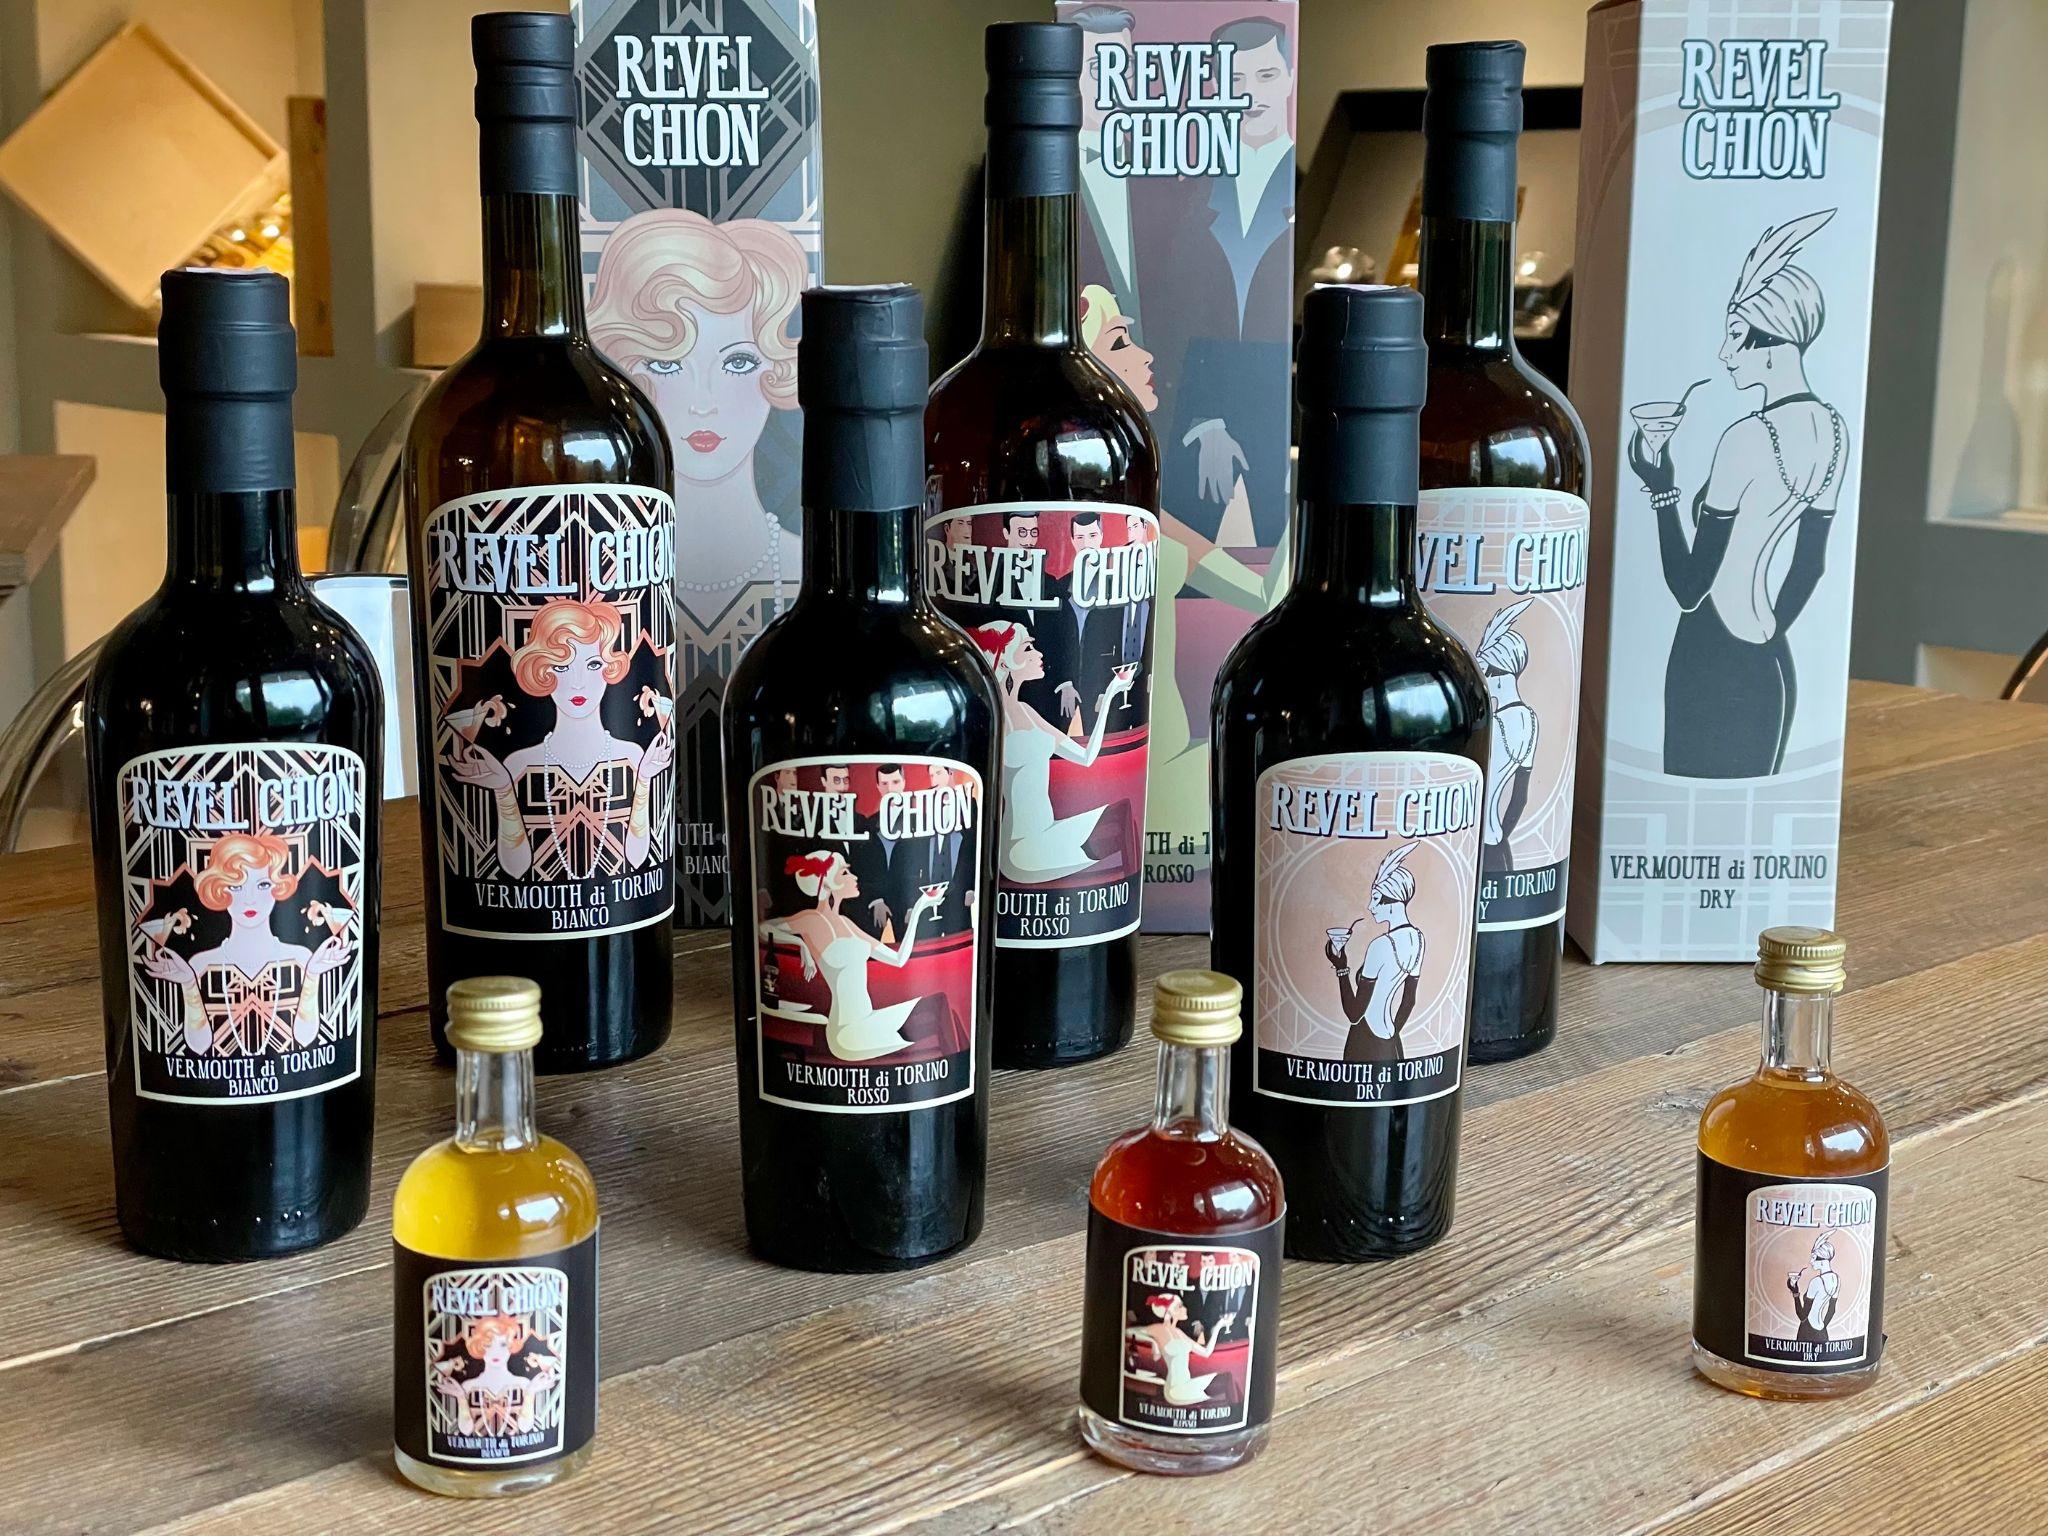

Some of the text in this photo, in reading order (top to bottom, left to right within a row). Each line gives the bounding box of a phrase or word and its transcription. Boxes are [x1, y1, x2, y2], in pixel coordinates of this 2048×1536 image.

[613, 35, 770, 99] REVEL
[1096, 43, 1252, 108] REVEL
[1680, 40, 1840, 109] REVEL
[623, 102, 761, 167] CHION
[1102, 111, 1242, 176] CHION
[1683, 111, 1830, 178] CHION
[436, 521, 676, 594] REVEL CHION
[926, 538, 1159, 608] REVEL CHION
[1416, 531, 1497, 595] VEL
[131, 767, 356, 831] REVEL CHION
[760, 784, 871, 841] REVEL
[879, 781, 974, 841] CHION
[1270, 778, 1479, 840] REVEL CHION
[1178, 835, 1195, 855] di
[1144, 863, 1195, 884] ROSSO
[1482, 867, 1556, 900] di TORINO
[1609, 855, 1828, 881] VERMOUTH di TORINO
[474, 867, 664, 910] VERMOUTH di TORINO
[997, 881, 1129, 916] OUTH di TORINO
[1699, 888, 1736, 909] DRY
[551, 906, 609, 930] BIANCO
[1020, 916, 1070, 937] ROSSO
[165, 1044, 336, 1080] VERMOUTH di TORINO
[786, 1058, 950, 1089] VERMOUTH di TORINO
[1286, 1055, 1444, 1084] VERMOUTH di TORINO
[228, 1076, 279, 1096] BIANCO
[847, 1087, 890, 1104] ROSSO
[1356, 1083, 1385, 1100] DRY
[1755, 1196, 1873, 1228] REVEL CHION
[1131, 1256, 1254, 1292] REVEL CHION
[432, 1277, 561, 1317] REVEL CHION
[1764, 1338, 1853, 1354] VERMOUTH di TORINO
[1803, 1352, 1819, 1362] DRY
